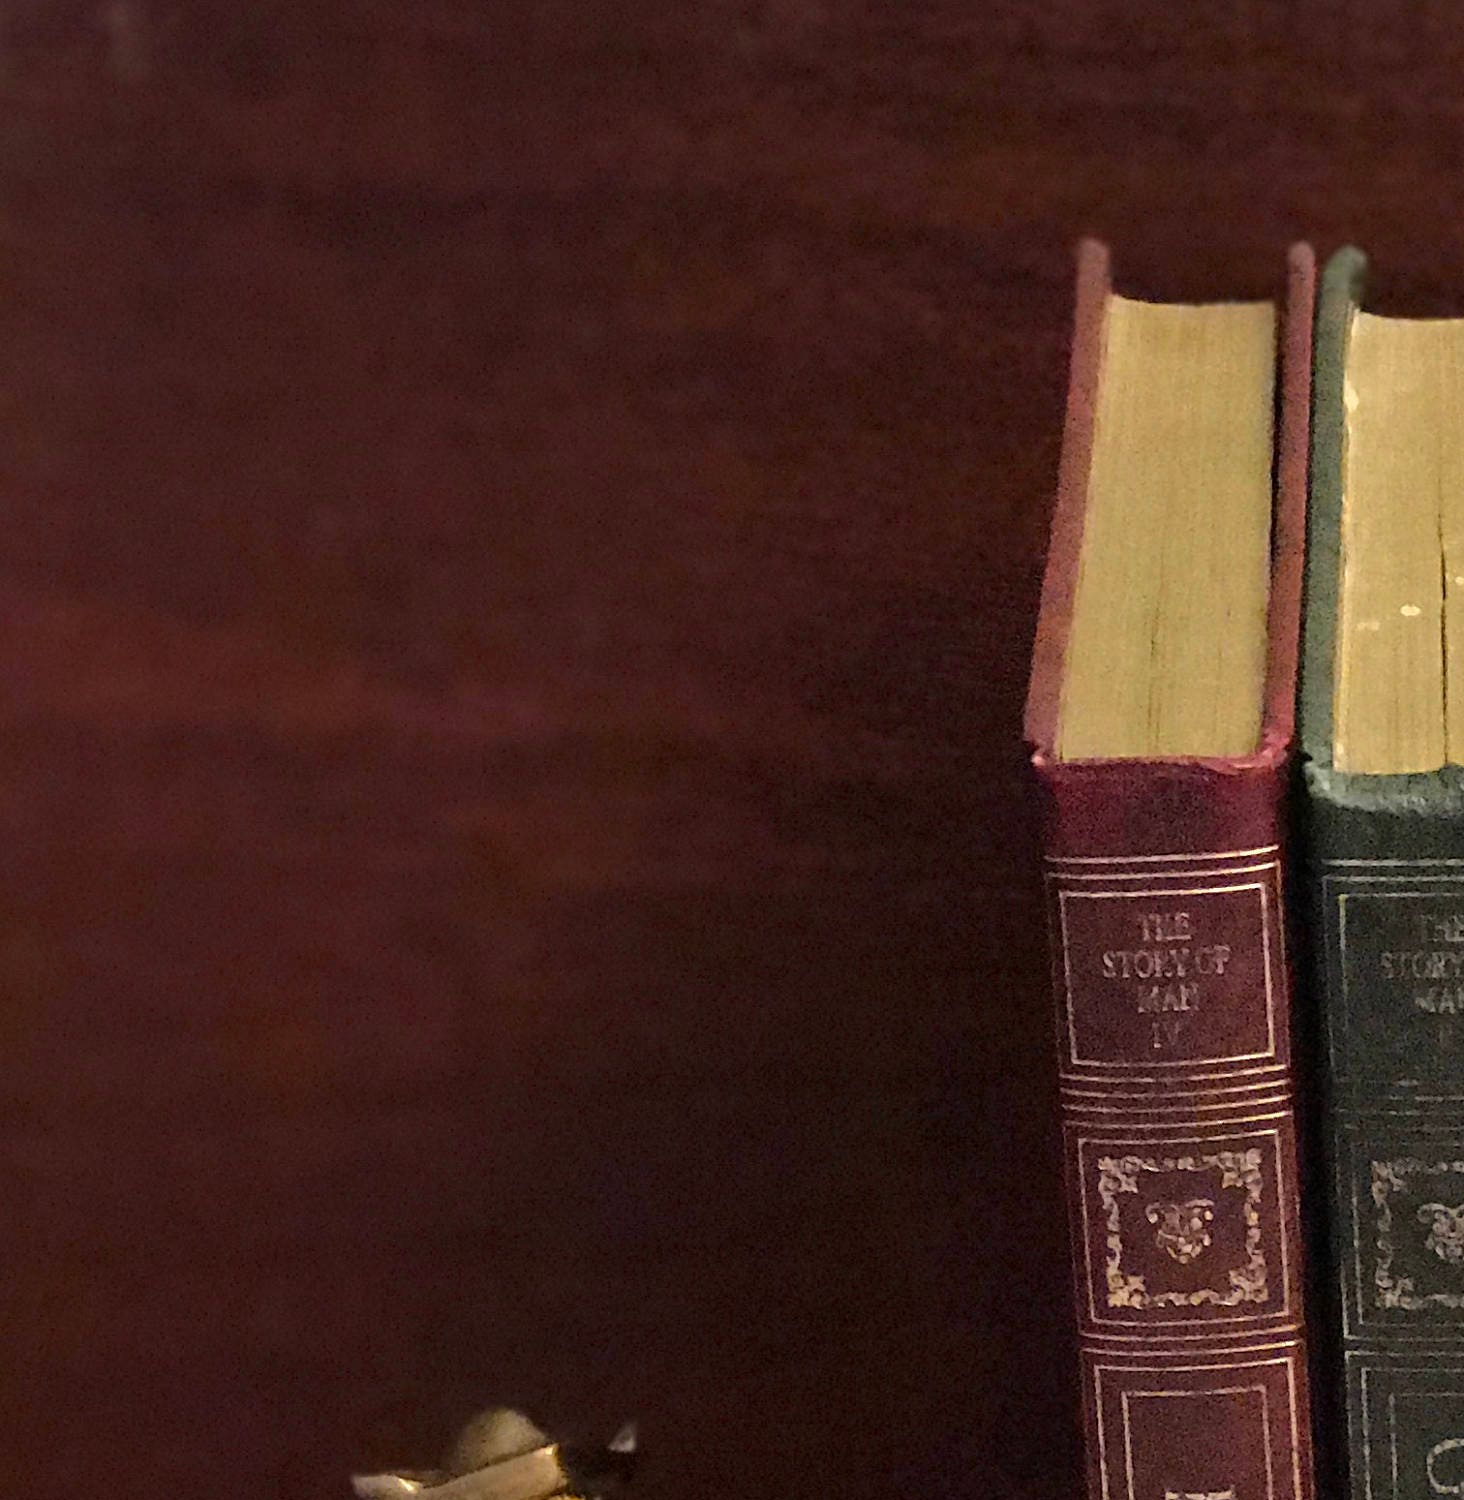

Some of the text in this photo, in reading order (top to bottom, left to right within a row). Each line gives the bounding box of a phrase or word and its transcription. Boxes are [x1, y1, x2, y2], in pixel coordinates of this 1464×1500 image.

[1102, 944, 1231, 978] STORY OF
[1381, 950, 1464, 979] STORY
